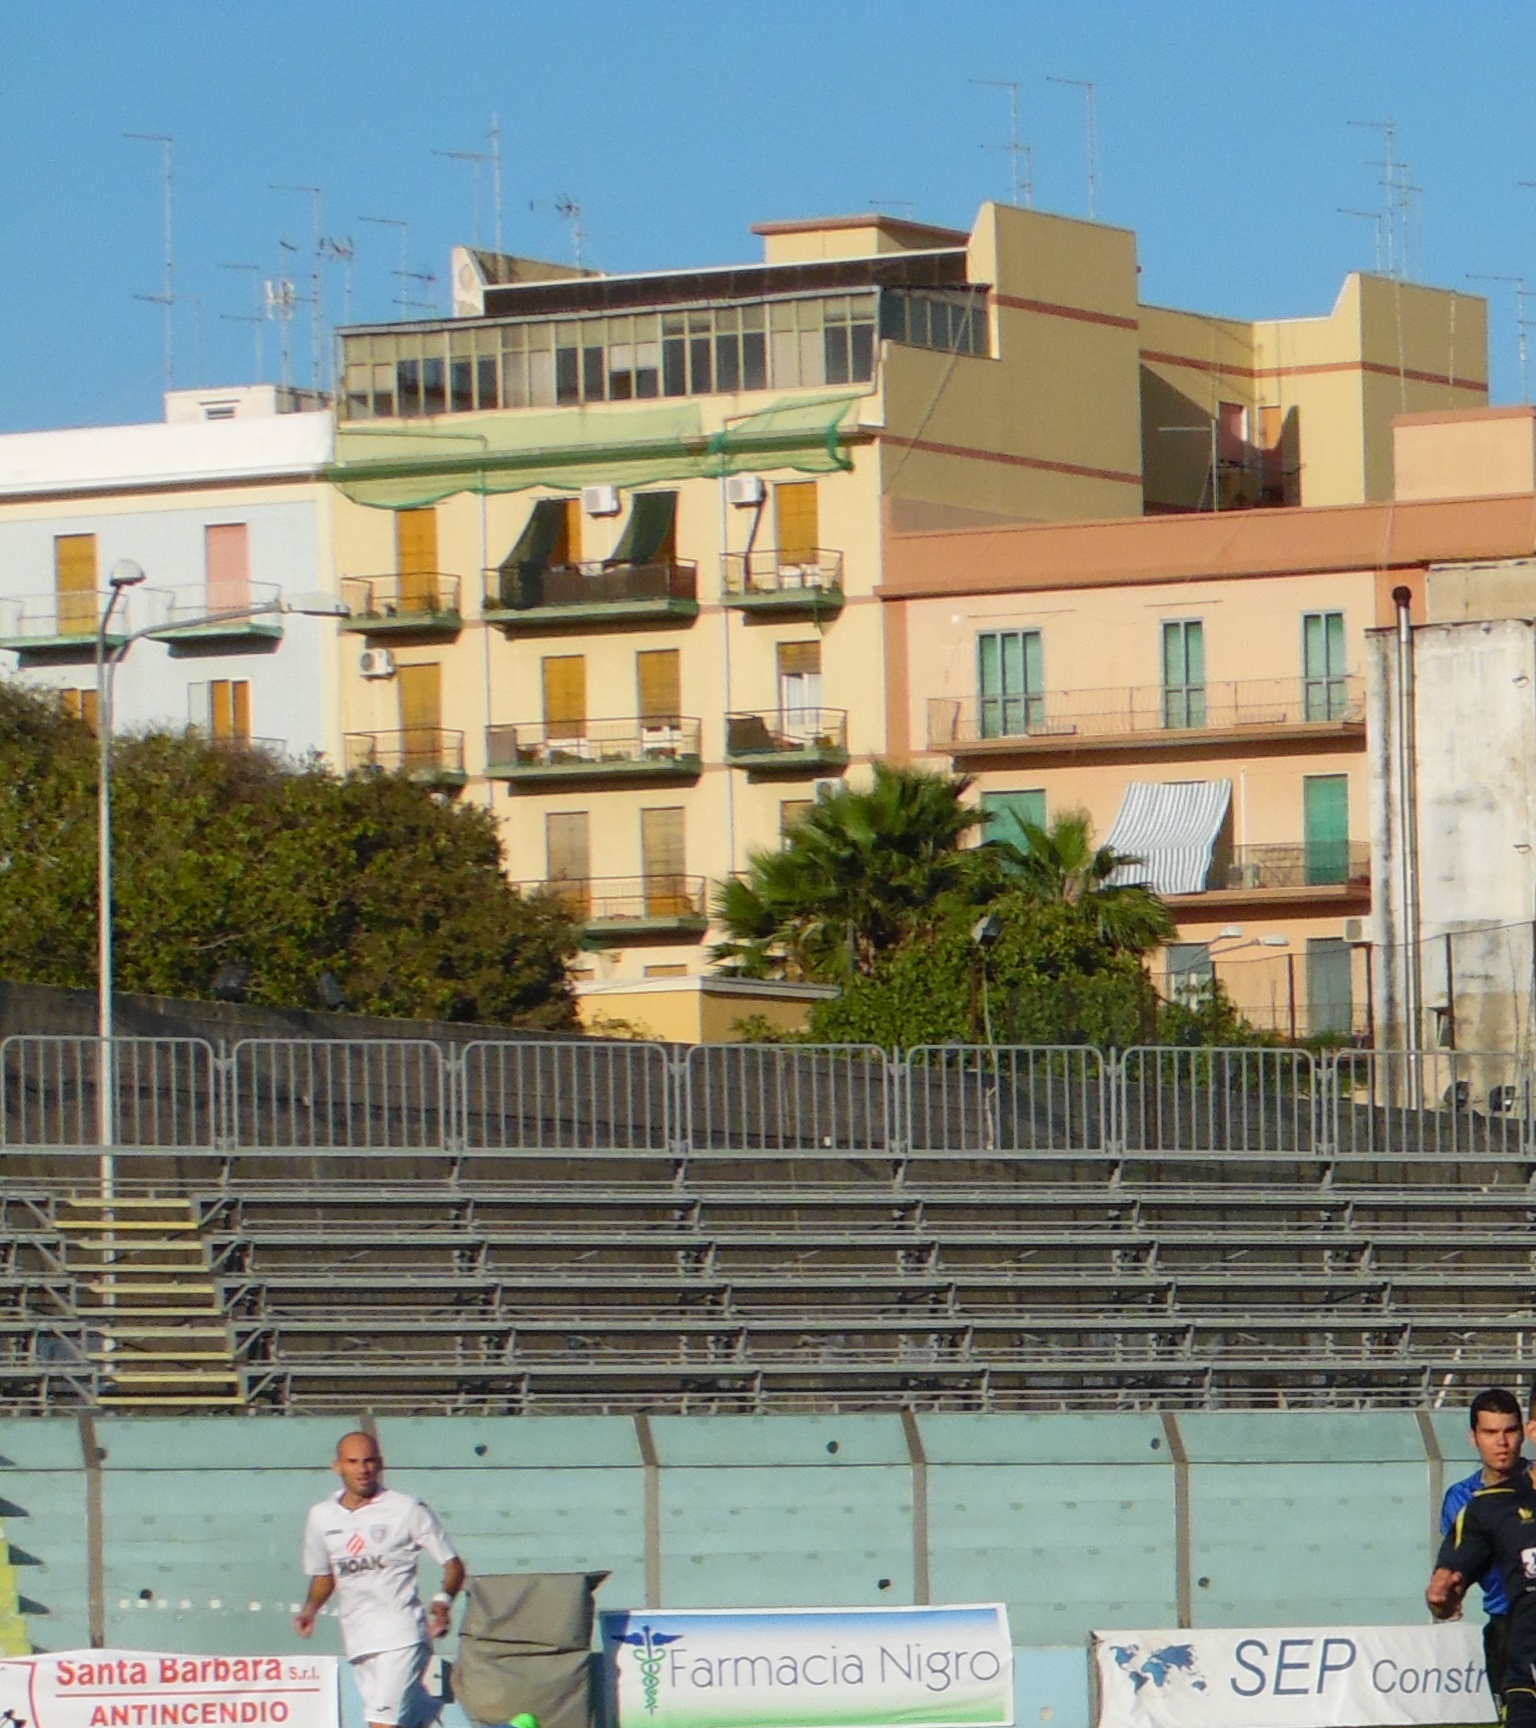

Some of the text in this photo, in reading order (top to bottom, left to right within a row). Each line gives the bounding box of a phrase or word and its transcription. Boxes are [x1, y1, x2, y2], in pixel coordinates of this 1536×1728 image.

[56, 1659, 148, 1686] Santa
[159, 1657, 283, 1684] Barbara
[669, 1643, 1001, 1692] Farmacia Nigro
[1230, 1638, 1358, 1697] SEP
[90, 1701, 289, 1727] ANTINCENDIO
